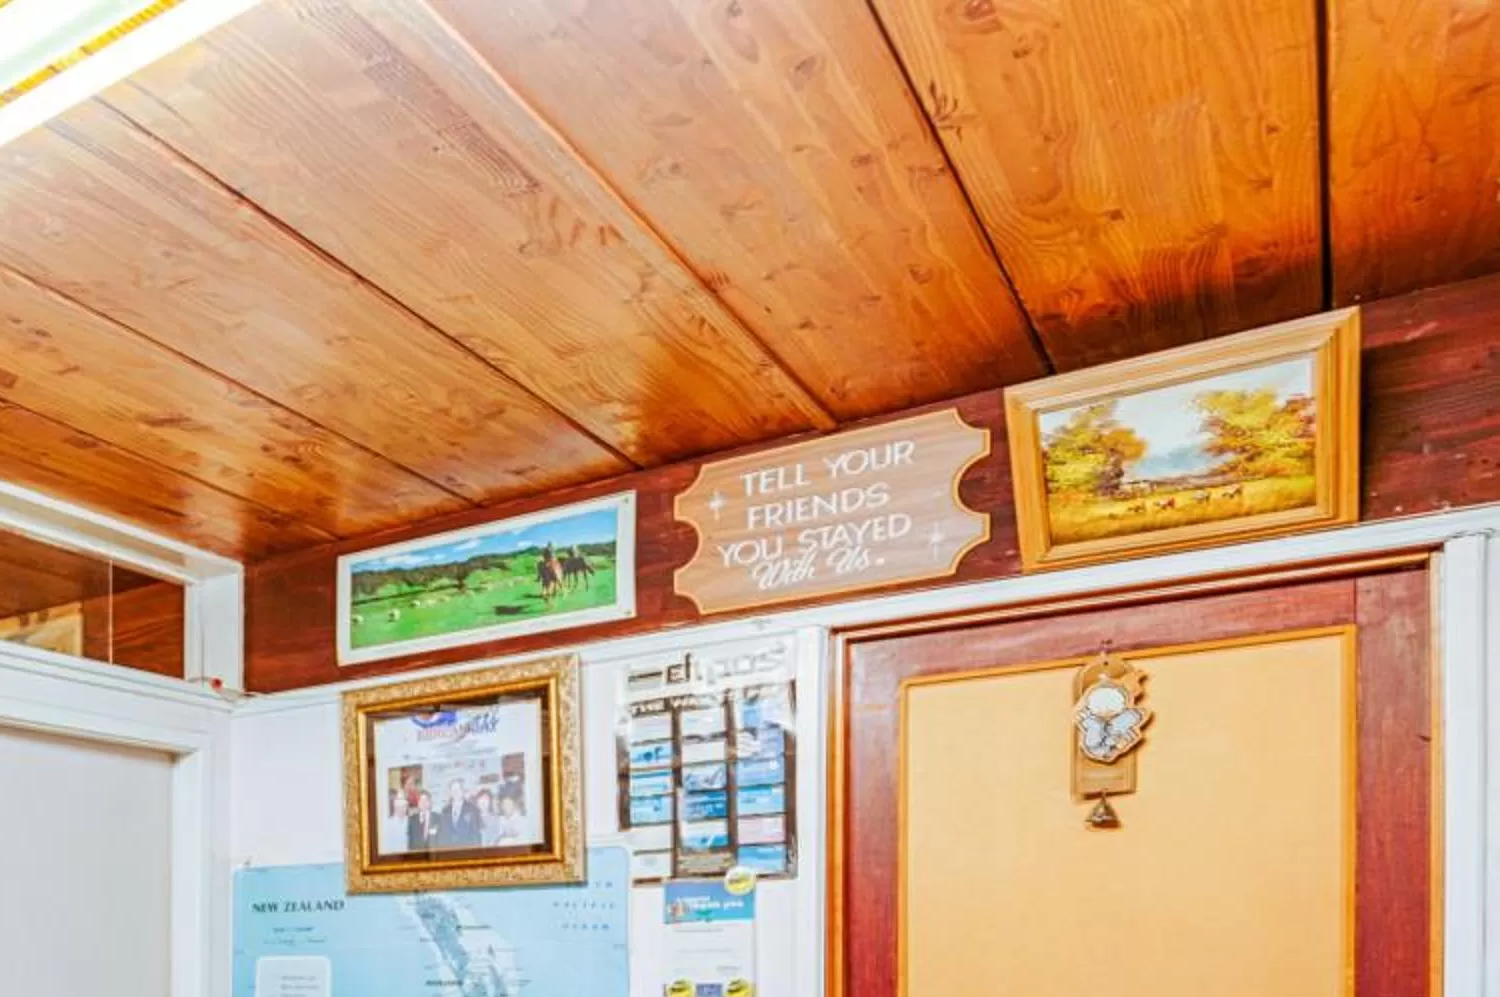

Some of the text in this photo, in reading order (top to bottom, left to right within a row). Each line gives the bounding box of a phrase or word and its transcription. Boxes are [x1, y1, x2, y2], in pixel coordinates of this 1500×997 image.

[739, 439, 916, 497] TELL YOUR
[746, 481, 891, 531] FRIENDS
[717, 512, 913, 569] YOU STAYED
[752, 547, 818, 592] With
[251, 899, 346, 914] NEW ZEALAND
